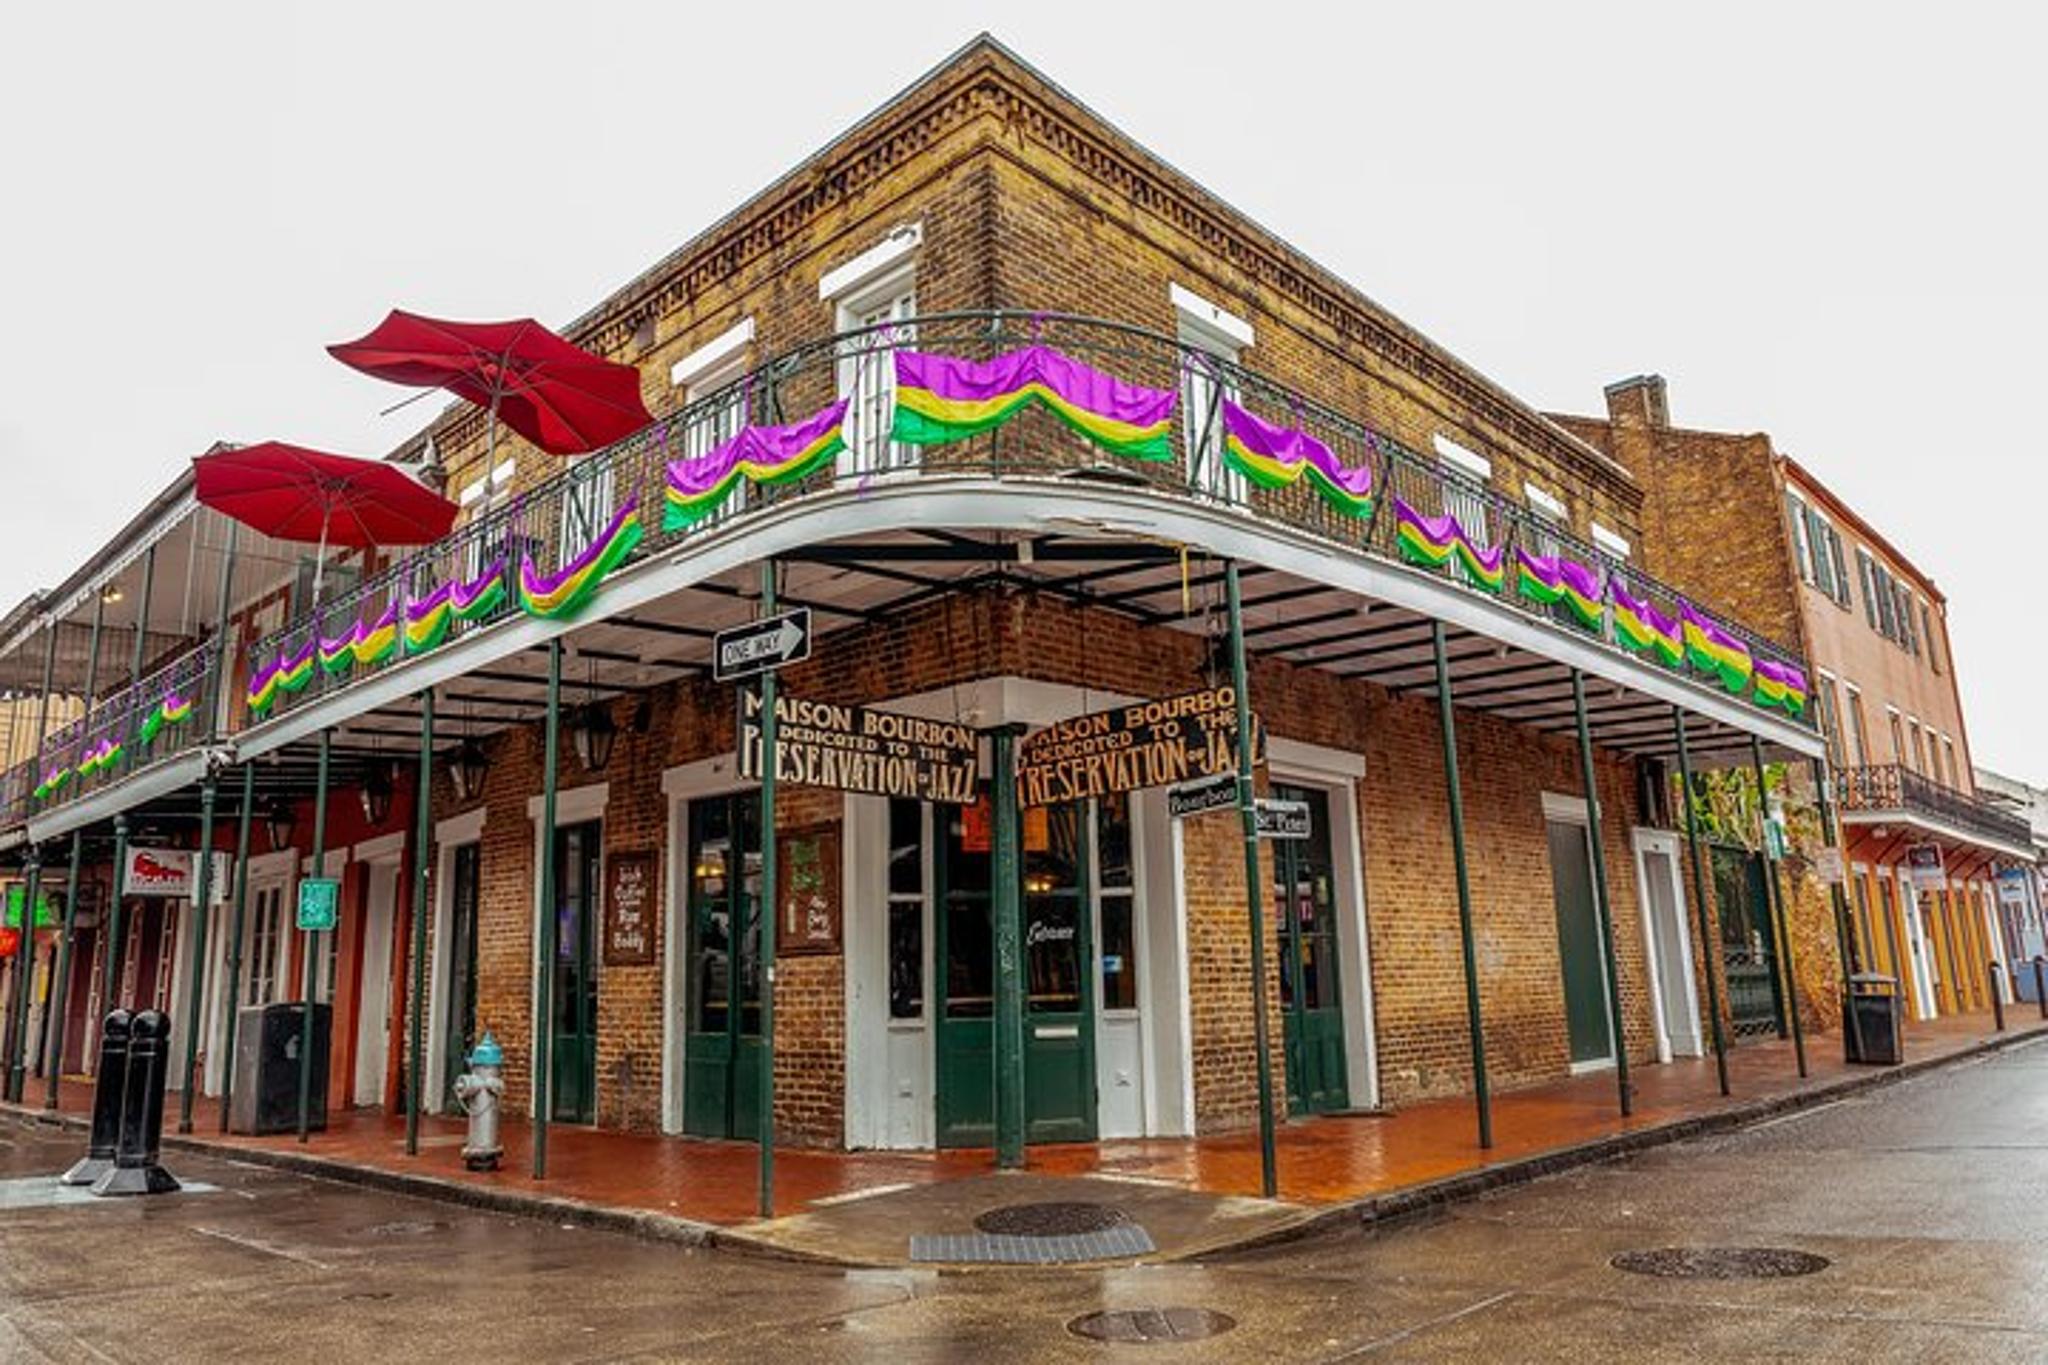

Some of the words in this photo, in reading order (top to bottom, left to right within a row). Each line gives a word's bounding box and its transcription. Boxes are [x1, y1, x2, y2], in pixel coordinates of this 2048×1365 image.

[724, 640, 751, 663] ONE
[752, 633, 781, 656] WAY
[744, 690, 852, 732] MAISON
[864, 710, 976, 752] BOURBON
[1124, 687, 1236, 729] BOURBO
[779, 725, 878, 752] DEDICATED
[886, 742, 910, 758] TO
[919, 745, 948, 762] THE
[1031, 730, 1134, 764] DEDICATED
[1149, 720, 1181, 741] TO
[926, 759, 977, 804] JAZZ
